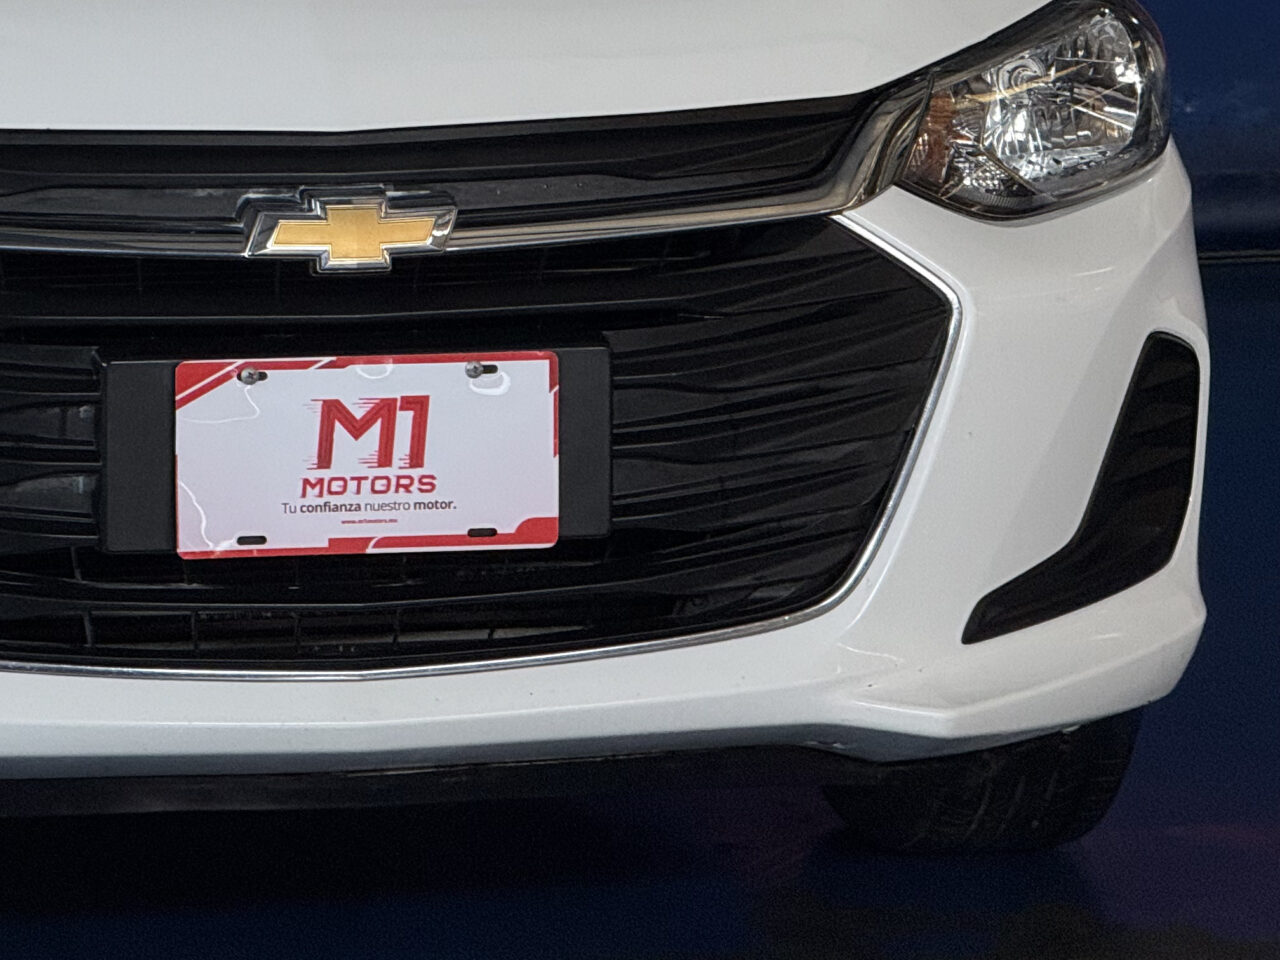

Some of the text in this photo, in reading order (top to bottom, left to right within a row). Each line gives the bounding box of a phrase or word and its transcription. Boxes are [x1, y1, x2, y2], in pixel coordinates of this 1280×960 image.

[304, 395, 431, 471] M1
[300, 474, 437, 498] MOTORS
[281, 499, 457, 514] Tu confianza nuestro motor.
